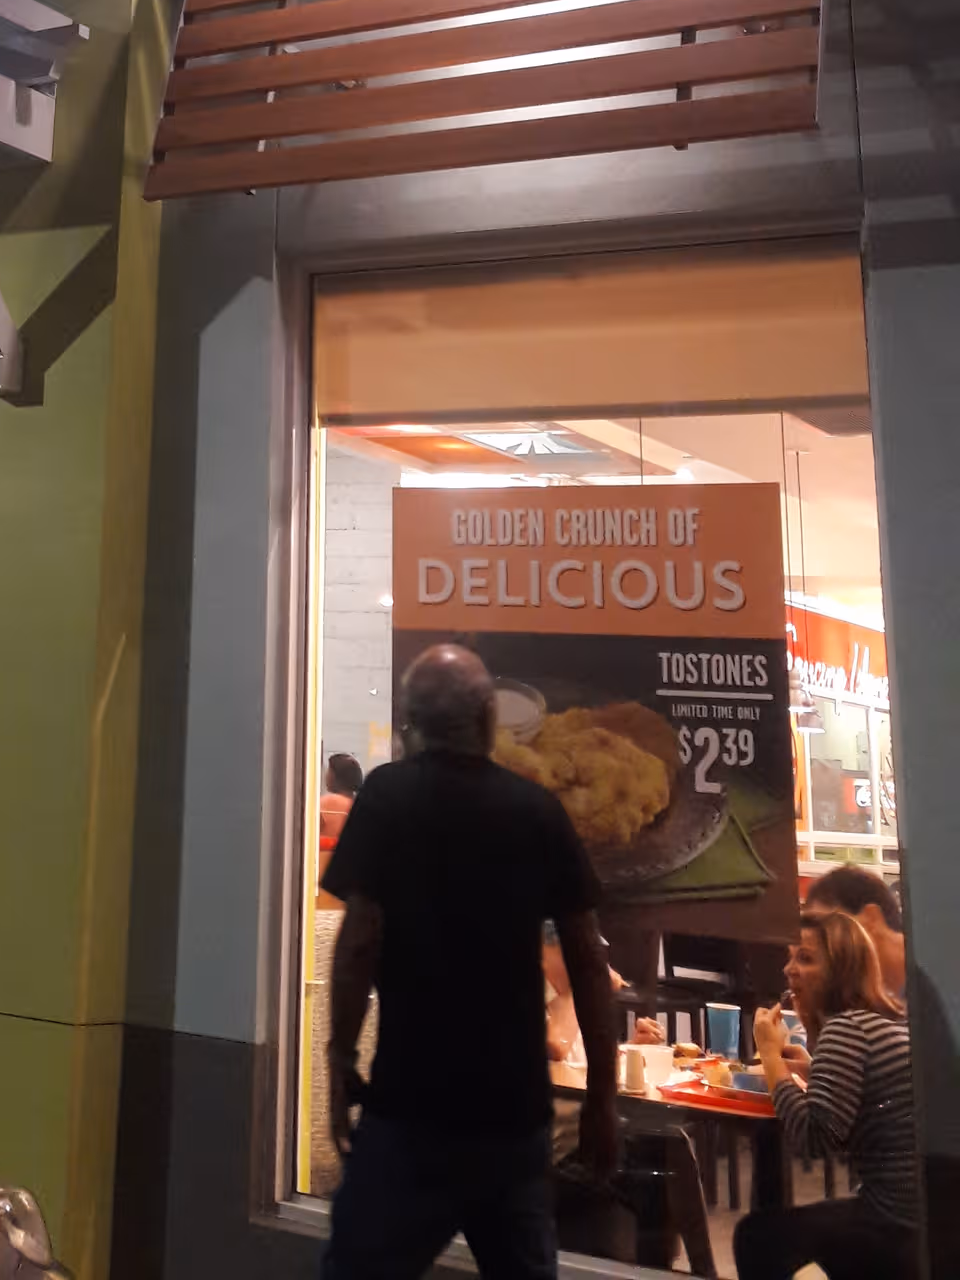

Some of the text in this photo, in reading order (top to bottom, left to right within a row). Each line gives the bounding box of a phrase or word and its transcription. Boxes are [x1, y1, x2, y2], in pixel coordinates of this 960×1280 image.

[452, 508, 699, 547] GOLDEN CRUNCH OF
[417, 558, 746, 611] DELICIOUS
[658, 652, 769, 687] TOSTONES
[671, 703, 760, 720] LIMITED TIME ONLY
